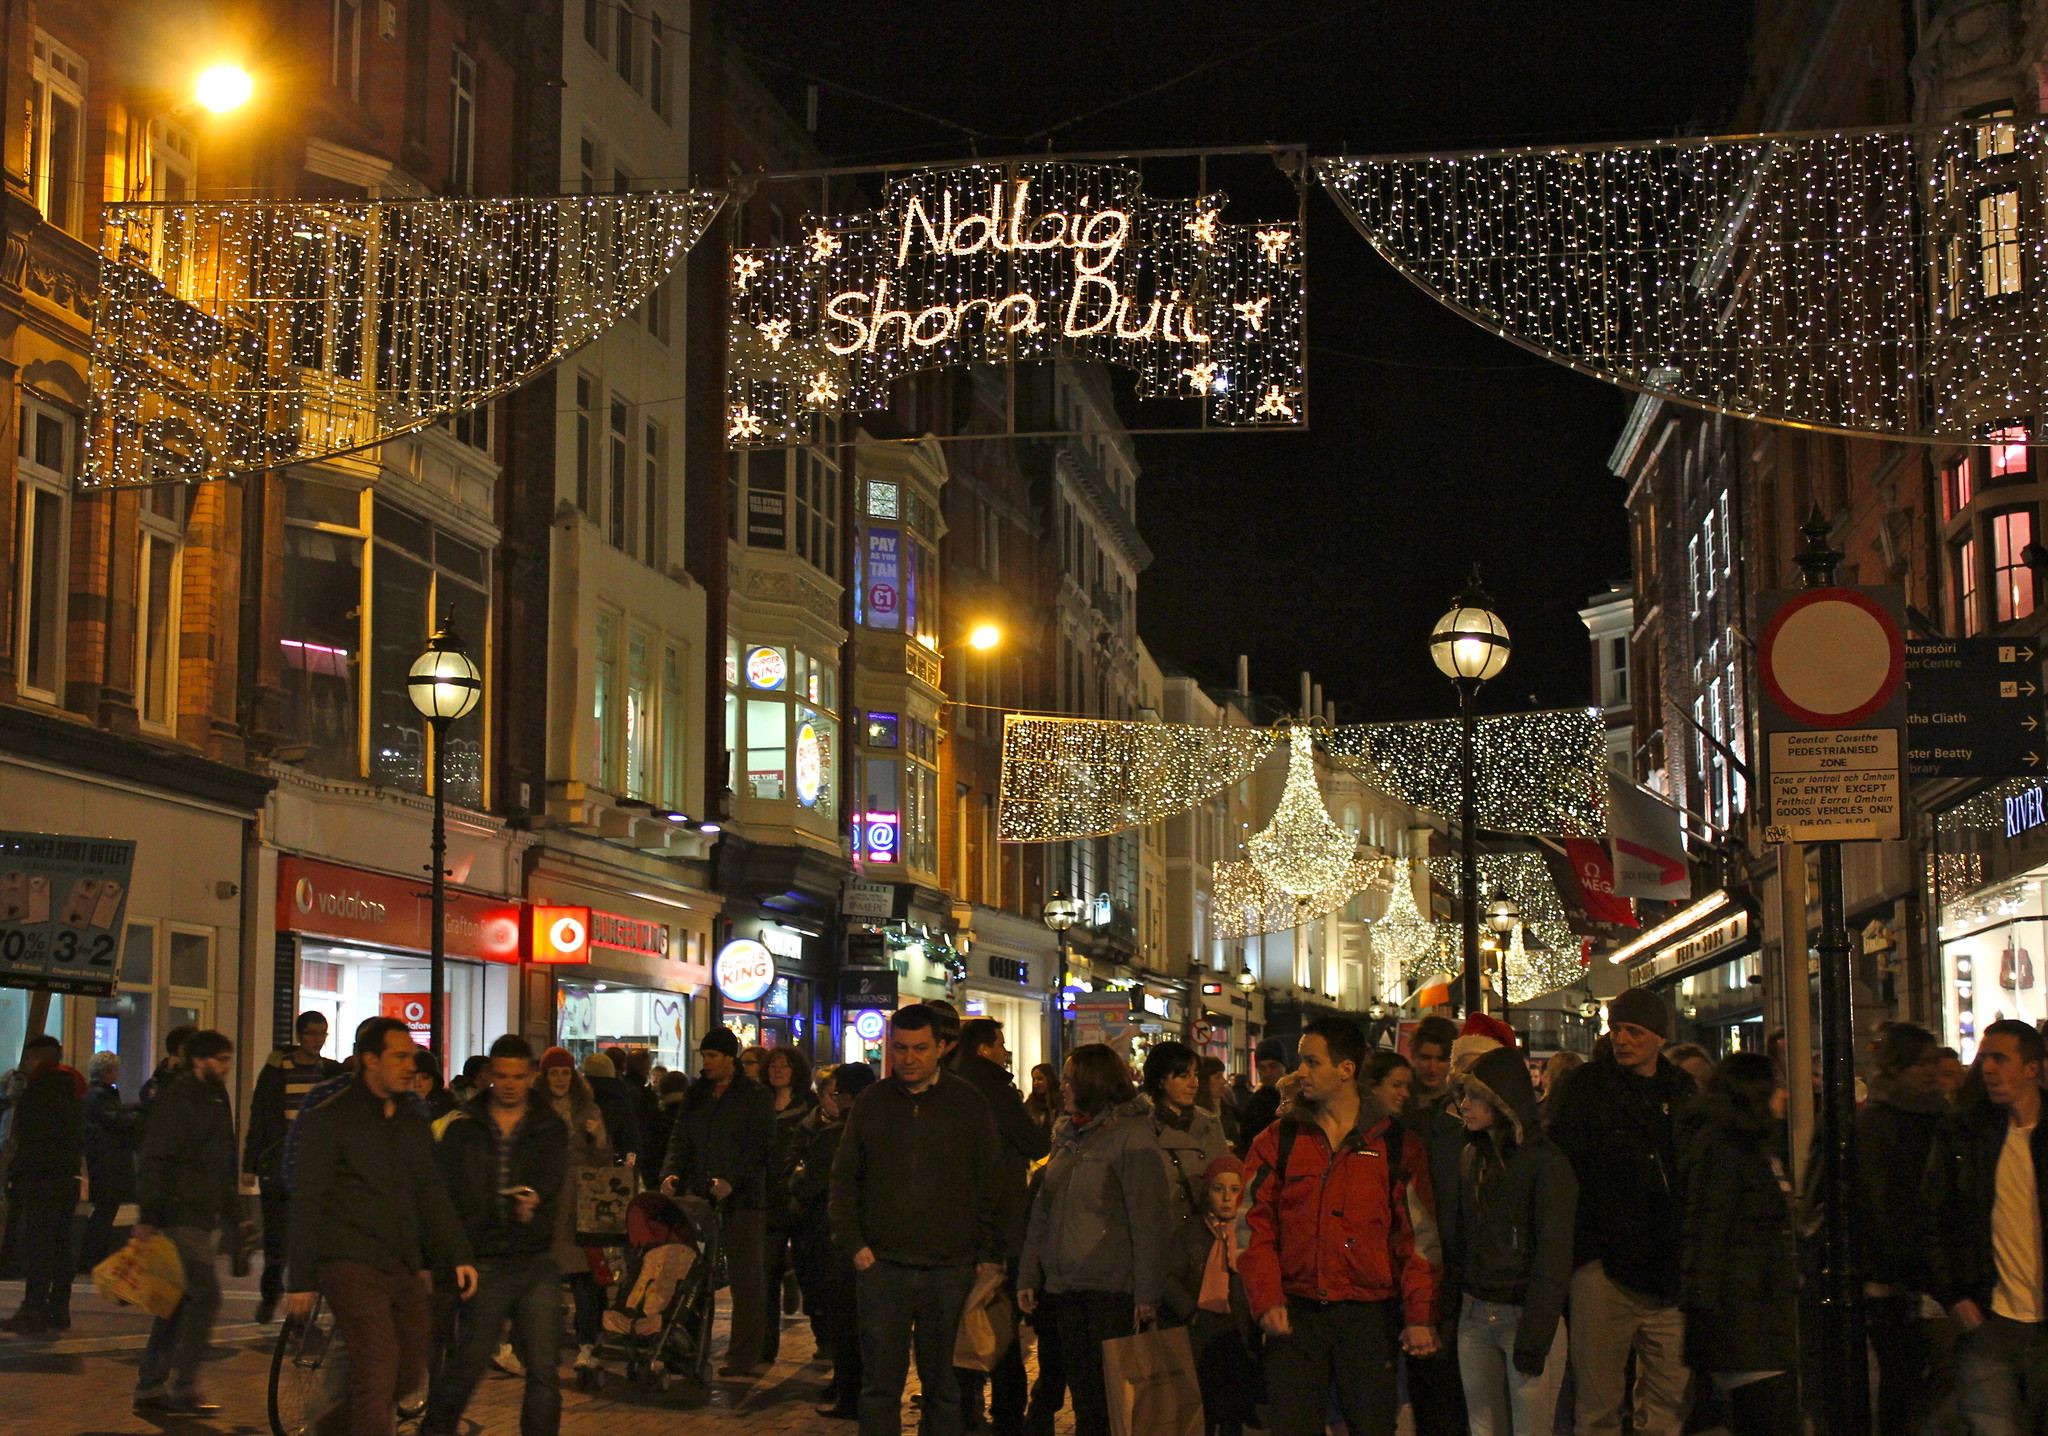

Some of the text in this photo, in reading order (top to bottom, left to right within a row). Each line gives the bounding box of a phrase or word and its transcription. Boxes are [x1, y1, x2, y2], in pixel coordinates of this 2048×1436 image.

[825, 277, 1047, 355] Shona
[869, 536, 896, 552] PAY
[870, 552, 896, 561] AS YOU
[869, 561, 896, 578] TAN
[750, 655, 780, 669] BURGER
[1922, 658, 1962, 669] Centre
[752, 663, 781, 681] KING
[1932, 712, 1967, 724] Cliath
[1788, 734, 1878, 745] Ceantar Coisithe
[1787, 745, 1879, 756] PEDESTRIANISED
[1934, 748, 1973, 761] Beatty
[1820, 758, 1847, 768] ZONE
[761, 773, 778, 781] THE
[1796, 775, 1806, 784] ar
[1843, 773, 1859, 782] ach
[1781, 783, 1887, 795] NO ENTRY EXCEPT
[1776, 805, 1894, 817] GOODS VEHICLES ONLY
[2005, 786, 2046, 838] RIVER
[56, 841, 88, 862] SHIRT
[89, 843, 129, 865] OUTLET
[852, 884, 887, 893] TO LET
[319, 889, 386, 923] vodafone
[444, 913, 480, 937] Grafton
[591, 913, 669, 955] BURGER KING
[53, 930, 78, 962] 3
[88, 934, 115, 966] 2
[23, 950, 46, 960] OFF
[722, 962, 767, 987] KING
[845, 994, 892, 1004] SWAROVSKI
